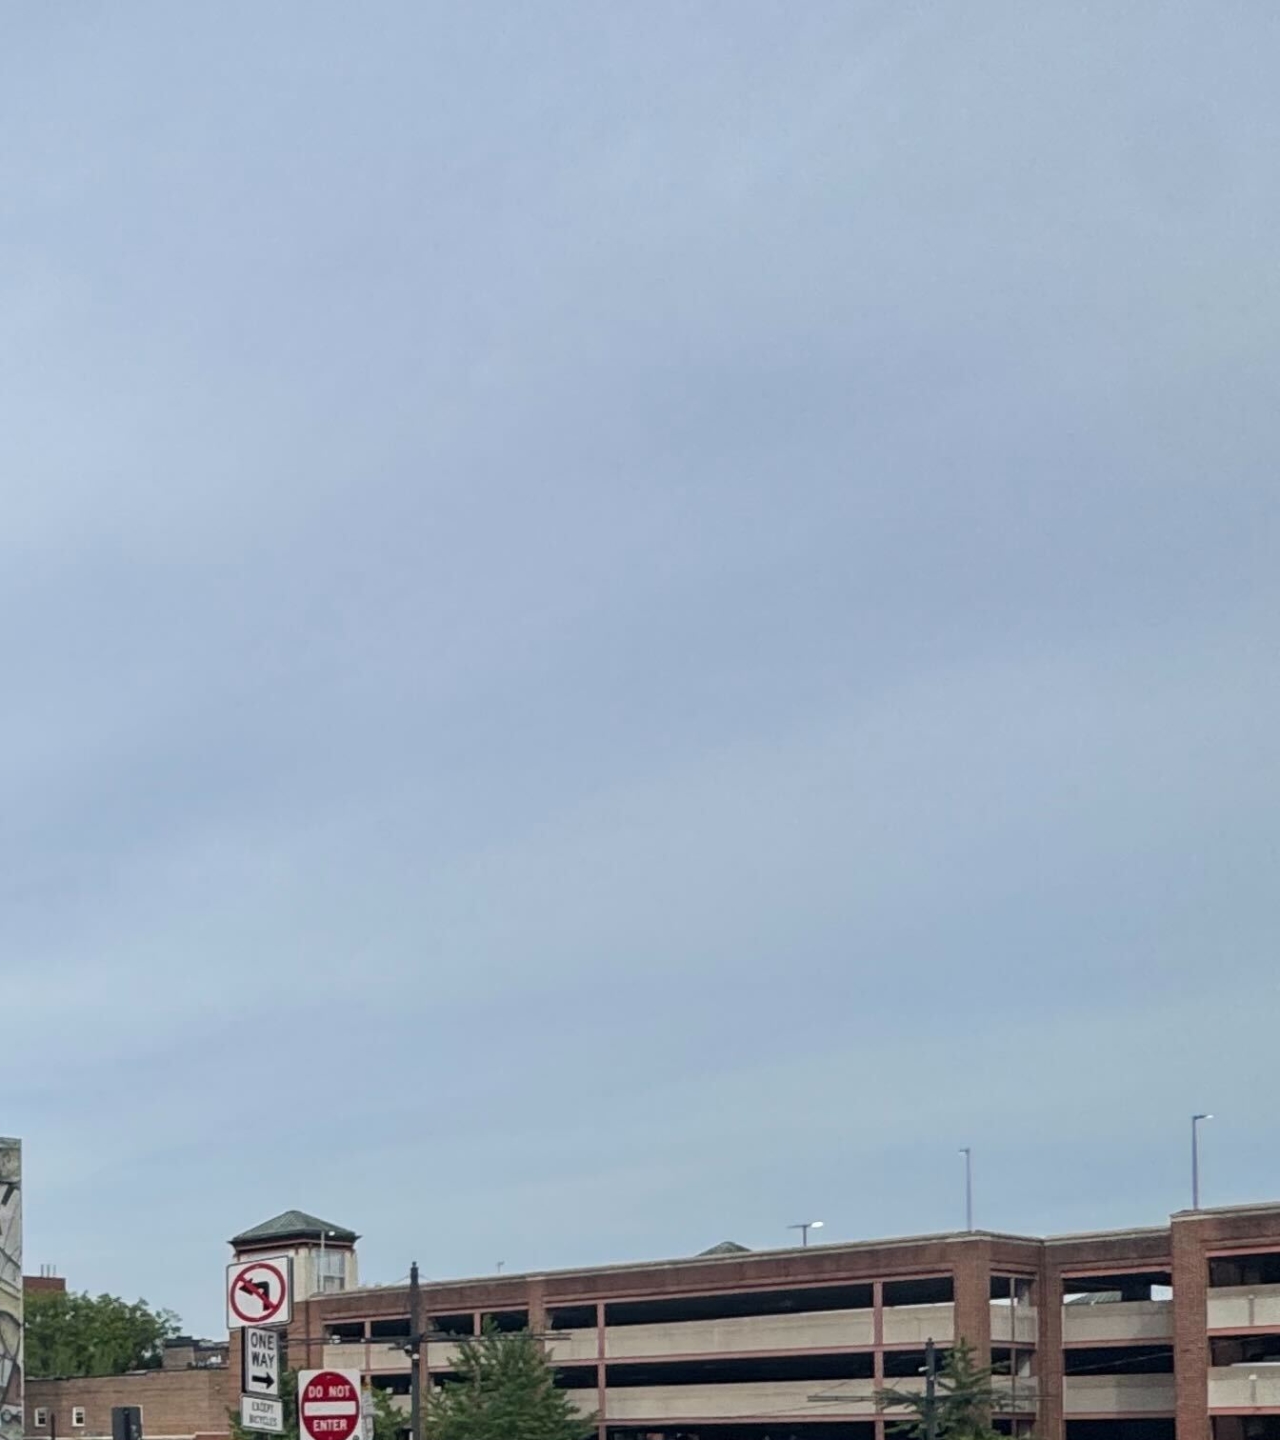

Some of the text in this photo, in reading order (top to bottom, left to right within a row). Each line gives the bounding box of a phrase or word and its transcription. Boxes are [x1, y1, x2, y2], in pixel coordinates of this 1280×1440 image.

[250, 1331, 274, 1350] ONE
[251, 1350, 275, 1369] WAY
[308, 1384, 351, 1398] DO NOT
[312, 1418, 348, 1432] ENTER
